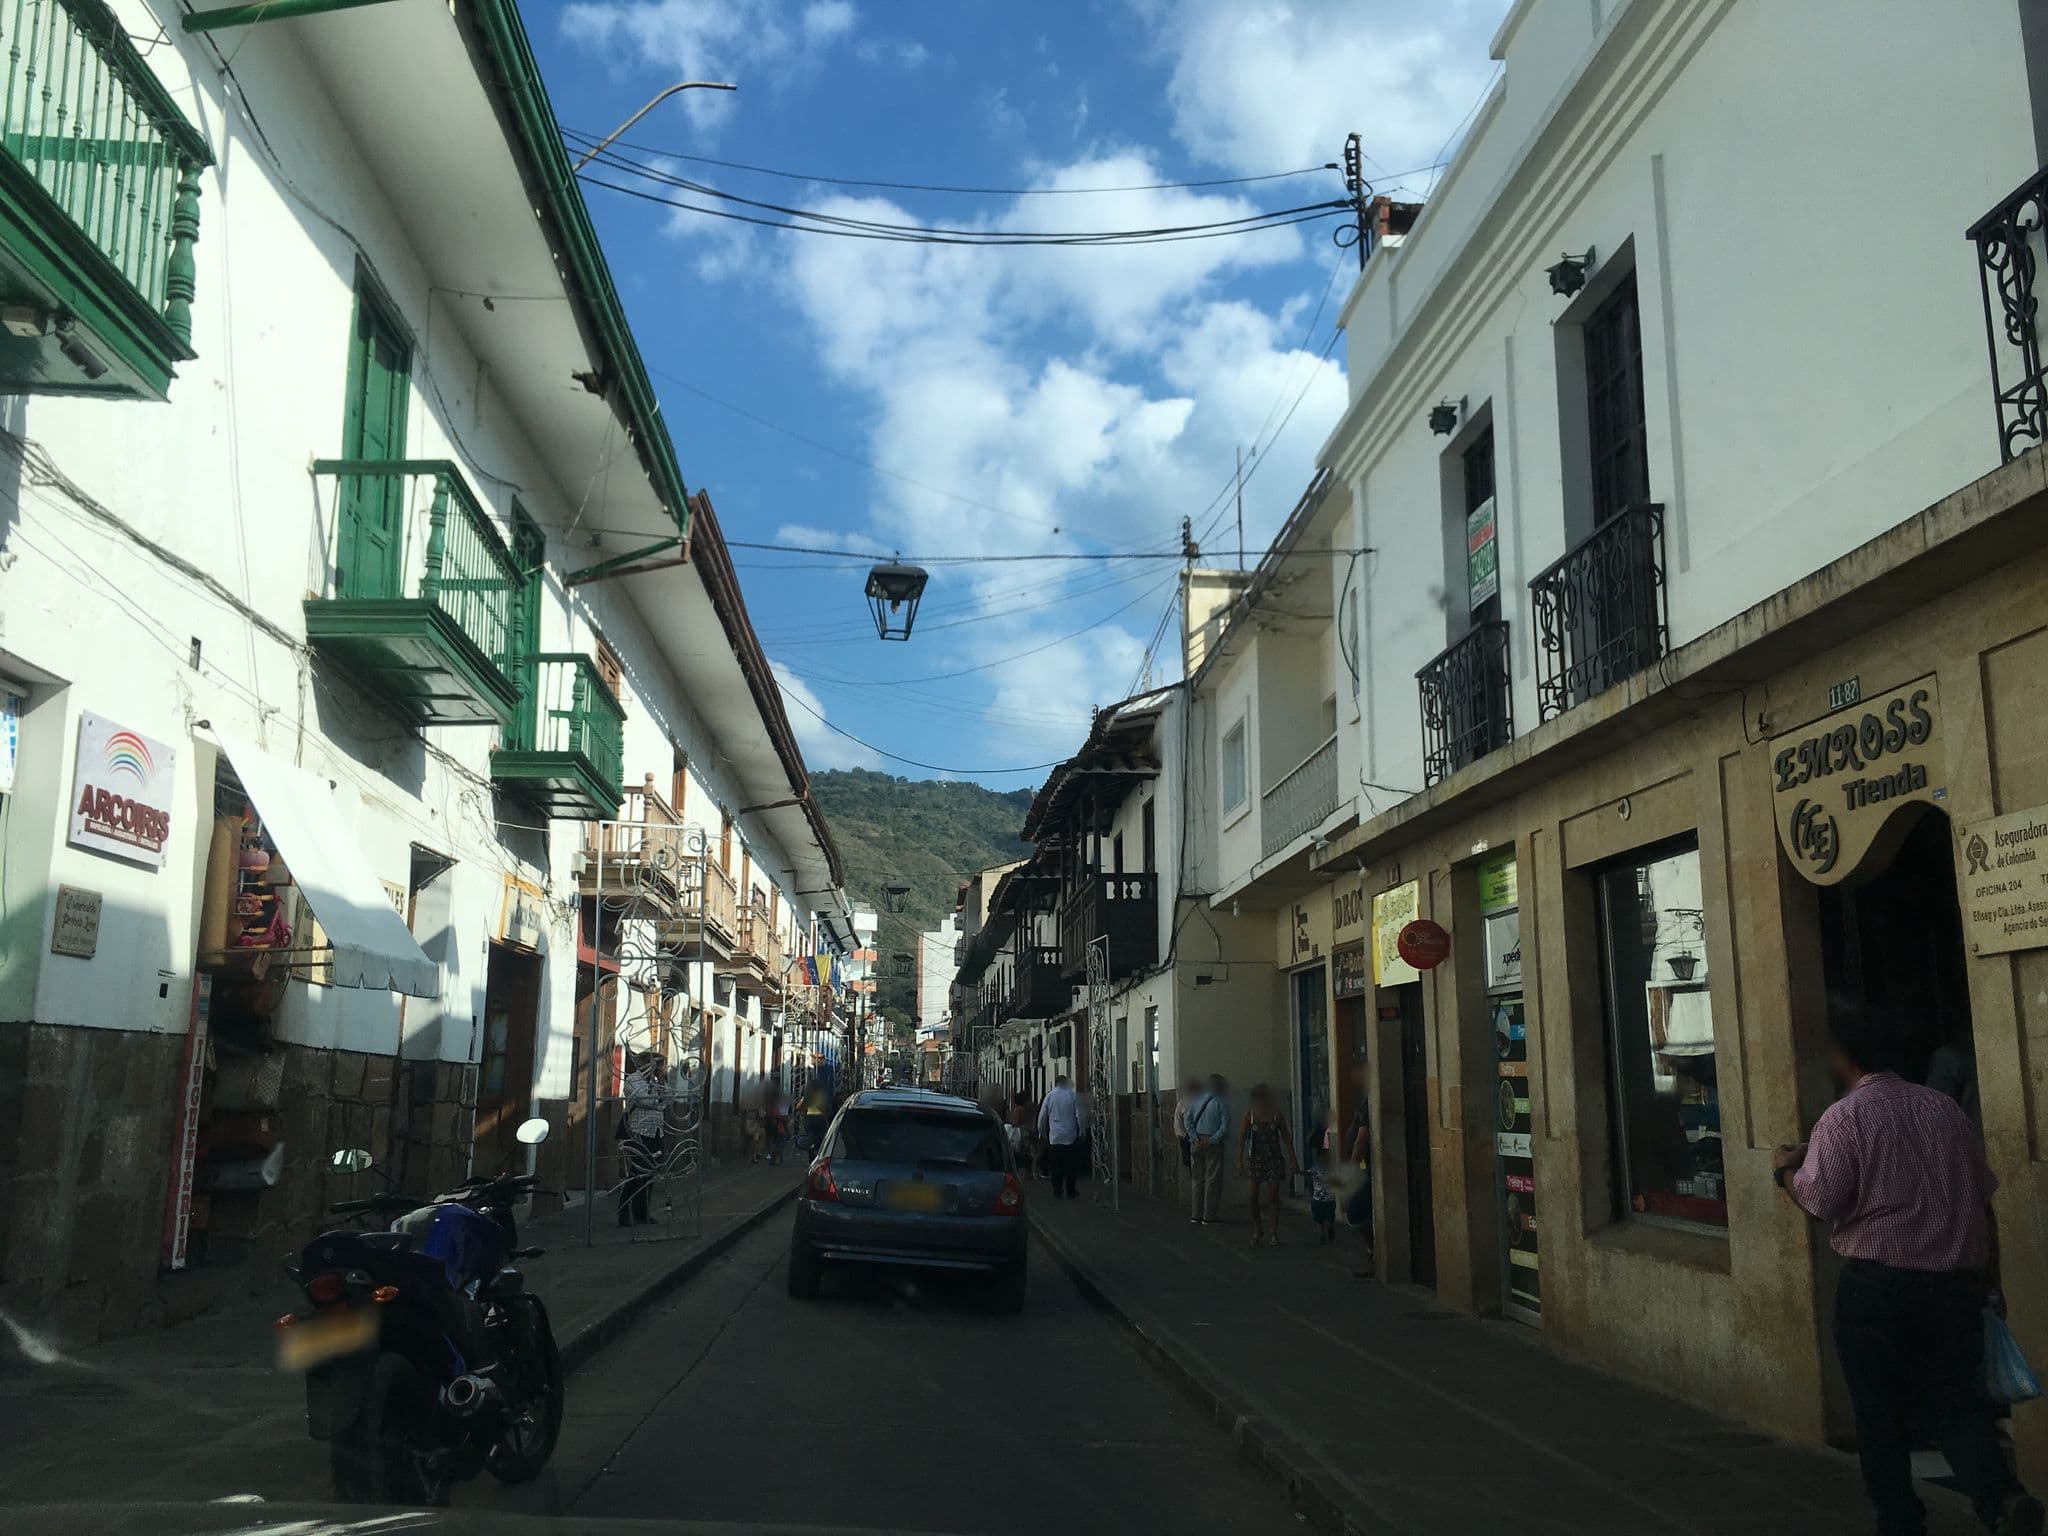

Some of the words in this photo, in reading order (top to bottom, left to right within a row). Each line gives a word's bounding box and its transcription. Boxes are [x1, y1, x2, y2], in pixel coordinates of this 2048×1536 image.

[1775, 689, 1932, 792] EMROSS
[1842, 762, 1928, 811] Tienda
[78, 783, 171, 842] ARCOIRIS
[1995, 821, 2048, 848] Aseguradora
[1997, 854, 2005, 868] de
[2005, 847, 2036, 866] Colombia
[1976, 883, 2007, 898] OFICINA
[2009, 879, 2022, 892] 204
